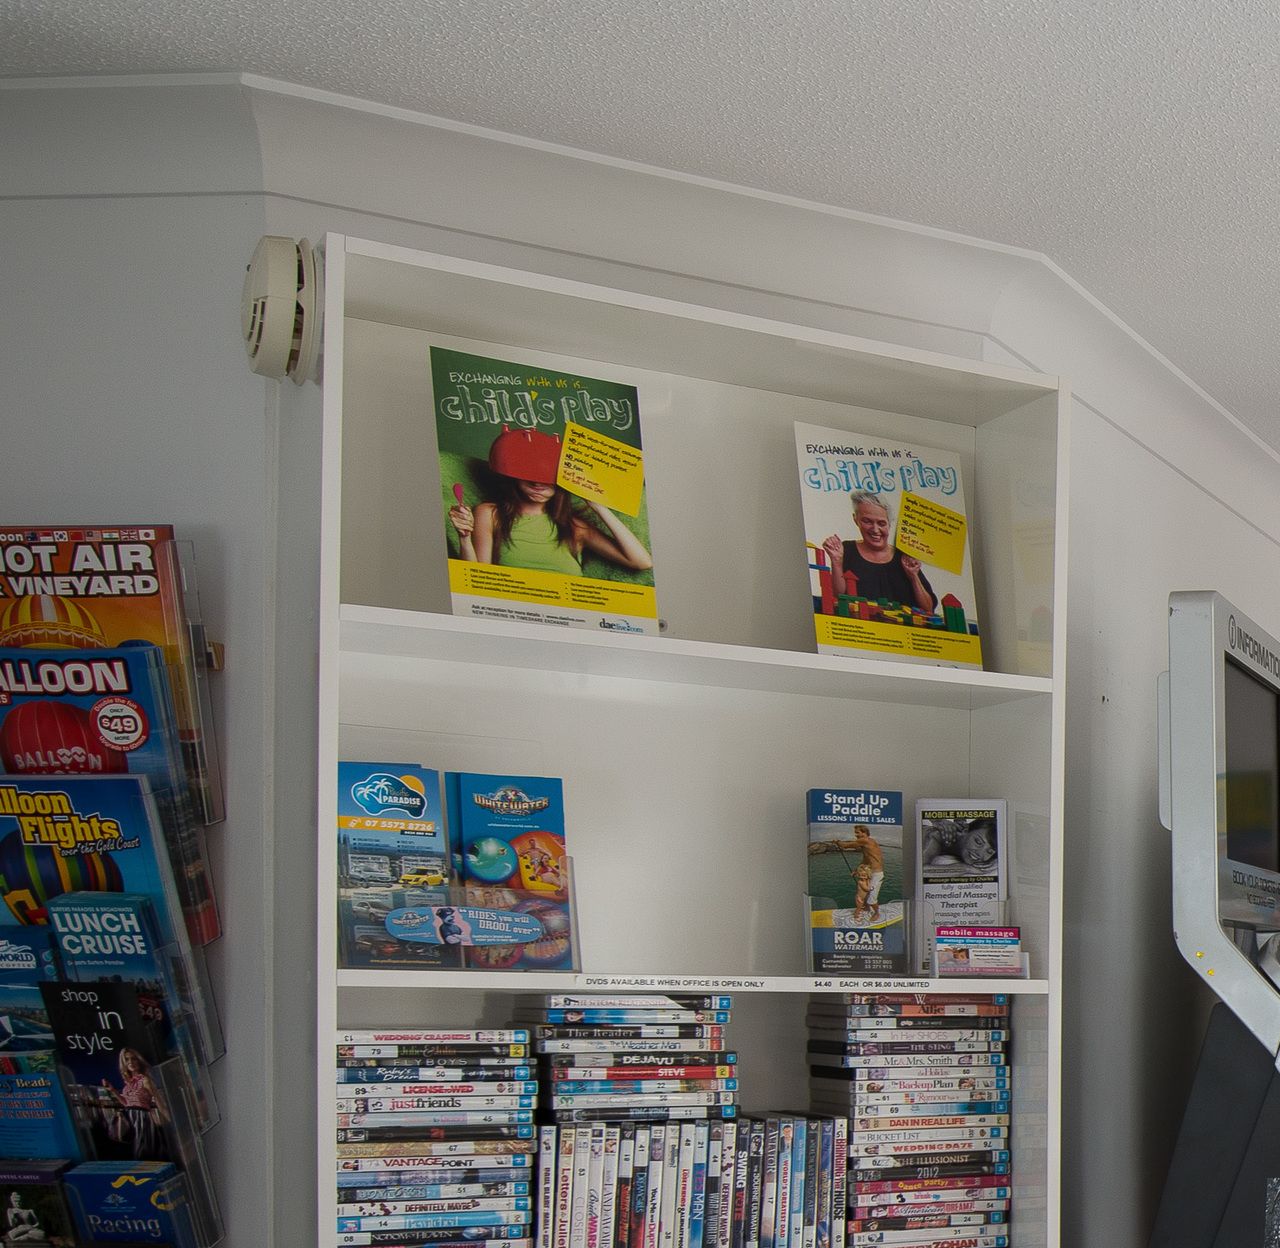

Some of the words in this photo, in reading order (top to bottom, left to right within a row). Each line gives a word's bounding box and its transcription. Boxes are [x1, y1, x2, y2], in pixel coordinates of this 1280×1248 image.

[449, 371, 521, 385] EXCHANGING
[440, 384, 556, 428] child's
[806, 444, 864, 456] EXCHANGING
[804, 457, 895, 495] child's
[0, 545, 57, 573] OT
[73, 544, 154, 572] AIR
[9, 575, 159, 596] VINEYARD
[101, 715, 138, 733] $49
[14, 746, 103, 770] BALLOON
[382, 795, 421, 806] PARADISE
[474, 794, 549, 812] WHITEWATER
[824, 793, 865, 806] Stand
[870, 793, 888, 808] Up
[832, 803, 881, 816] Paddle
[817, 815, 848, 823] LESSONS
[924, 811, 955, 819] MOBILE
[22, 815, 120, 849] Flights
[364, 819, 378, 827] 07
[380, 820, 406, 829] 5572
[407, 822, 433, 832] 8726
[54, 913, 141, 933] LUNCH
[61, 935, 148, 956] CRUISE
[834, 931, 883, 945] ROAR
[61, 989, 99, 1006] shop
[96, 1006, 124, 1031] in
[66, 1033, 114, 1056] style
[373, 1032, 418, 1042] WEDDING
[420, 1031, 472, 1041] CRASHERS
[889, 1119, 909, 1127] DAN
[921, 1118, 945, 1126] REAL
[946, 1117, 966, 1125] LIFE
[735, 1150, 748, 1188] SWING
[917, 1167, 939, 1179] 2012
[833, 1191, 845, 1221] HOUSE
[87, 1215, 162, 1237] Racing
